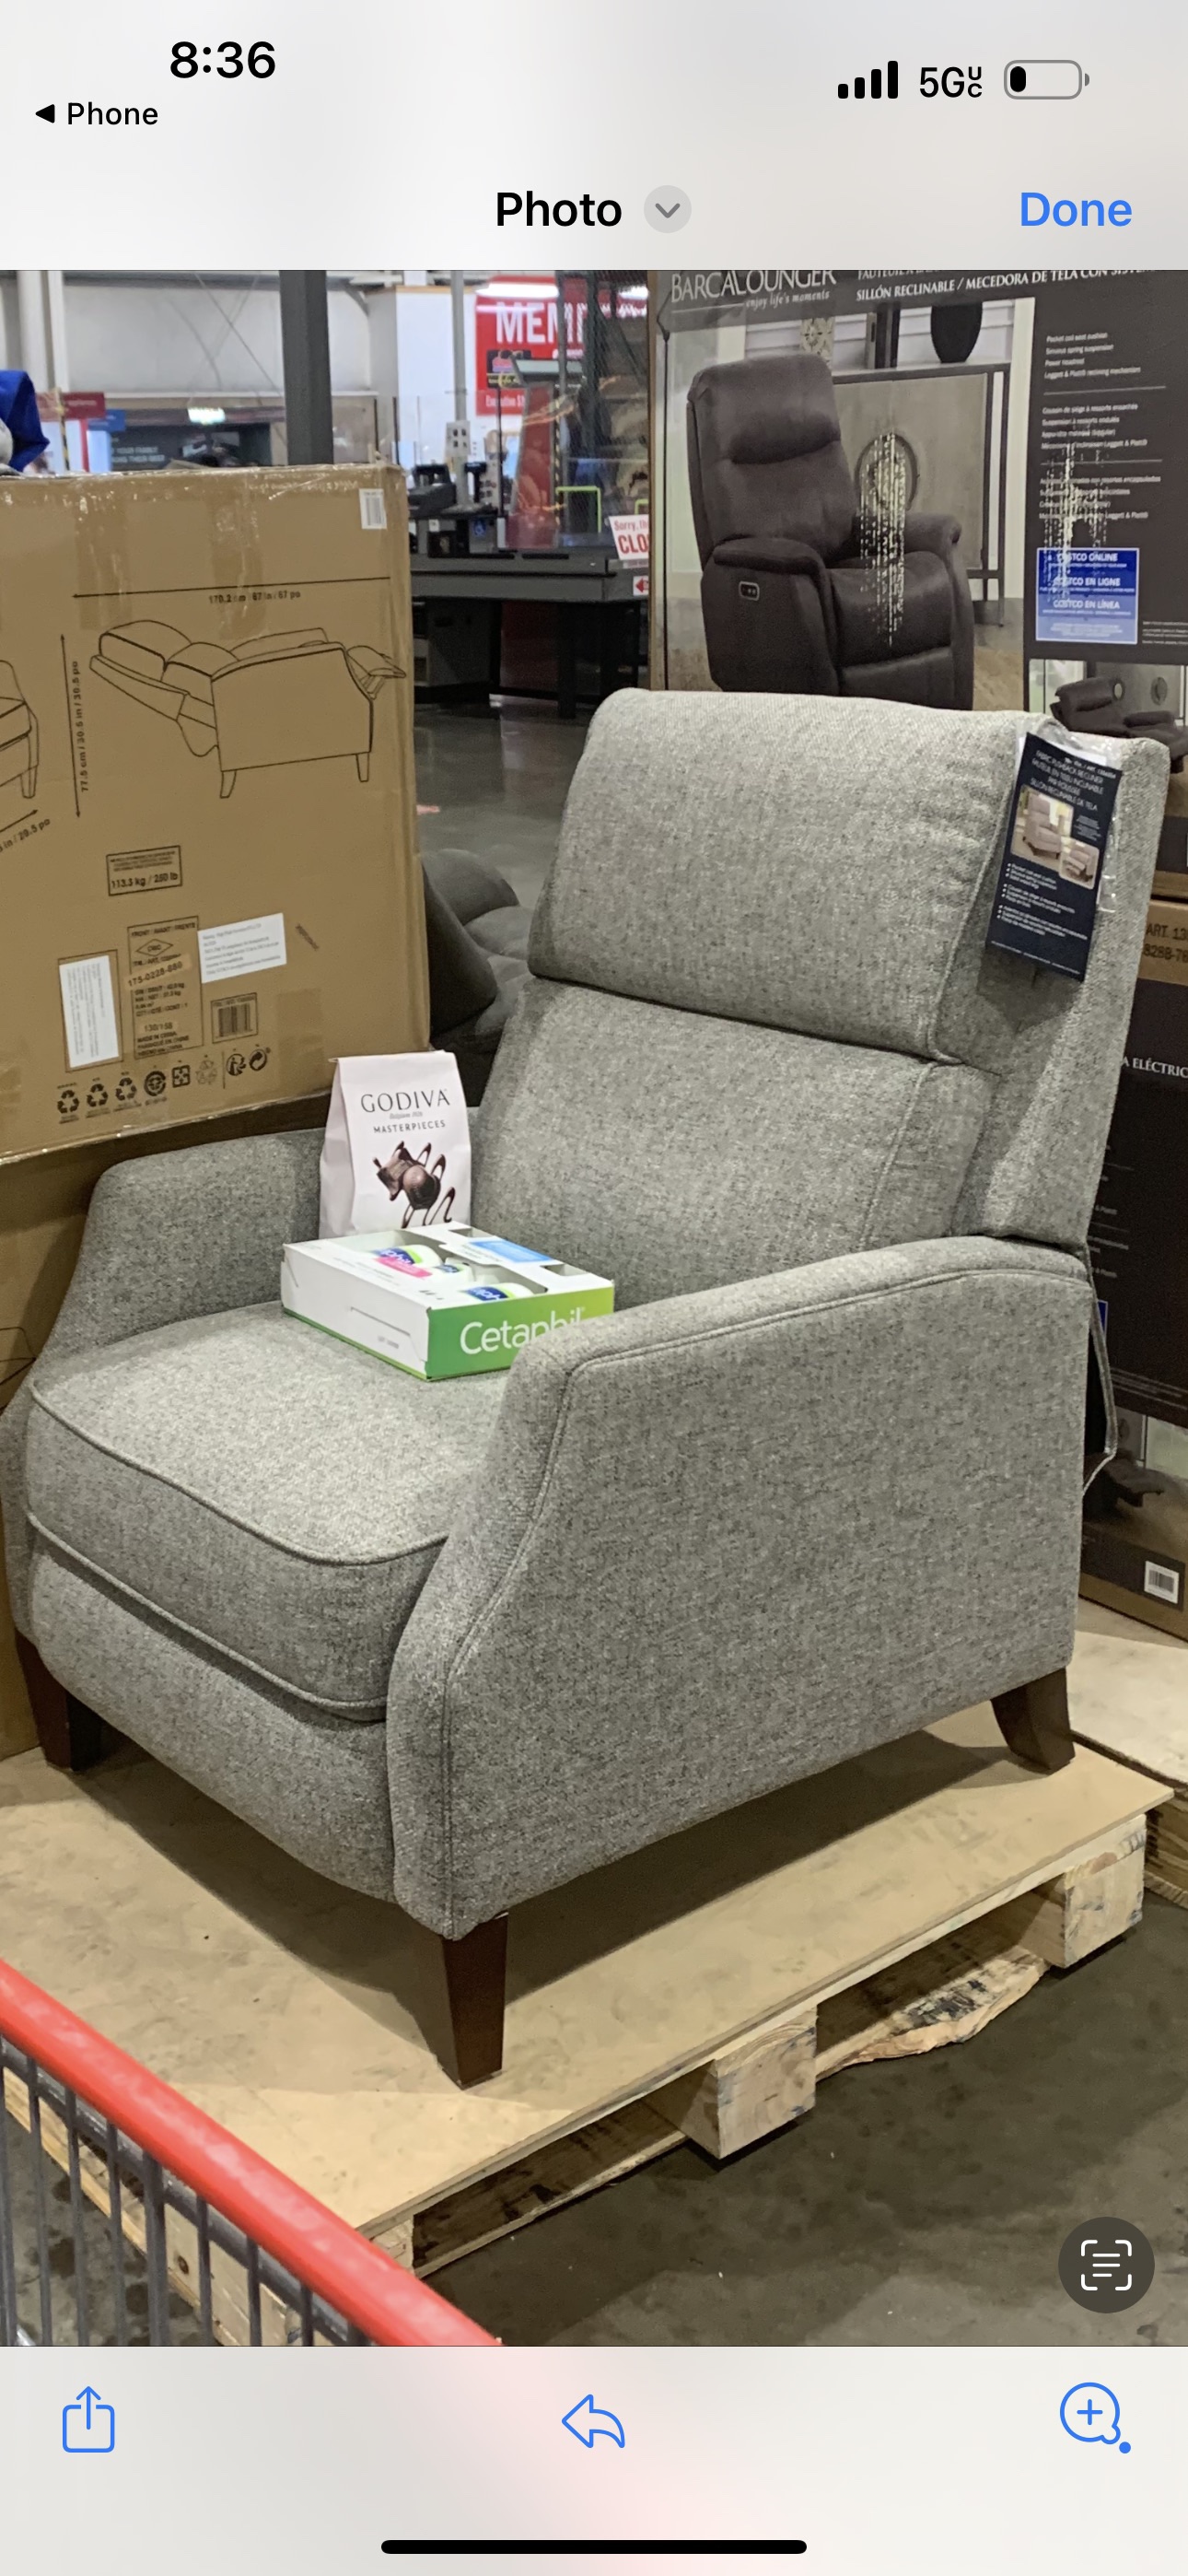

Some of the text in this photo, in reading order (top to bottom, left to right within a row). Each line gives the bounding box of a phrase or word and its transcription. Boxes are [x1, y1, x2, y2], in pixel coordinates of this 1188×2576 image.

[671, 270, 836, 302] BARCALOUNGER
[856, 284, 891, 301] SILLÓN
[894, 279, 956, 298] RECLINABLE
[965, 273, 1029, 290] MECEDORA
[1031, 271, 1048, 284] DE
[746, 289, 830, 310] enjoy life's moments
[618, 533, 649, 555] CLO
[1089, 552, 1118, 562] ONLINE
[1085, 577, 1097, 586] EN
[1098, 577, 1121, 587] LIGNE
[1084, 600, 1097, 609] EN
[1172, 928, 1188, 942] 13
[360, 1089, 450, 1113] GODIVA
[373, 1119, 446, 1133] MASTERPIECES
